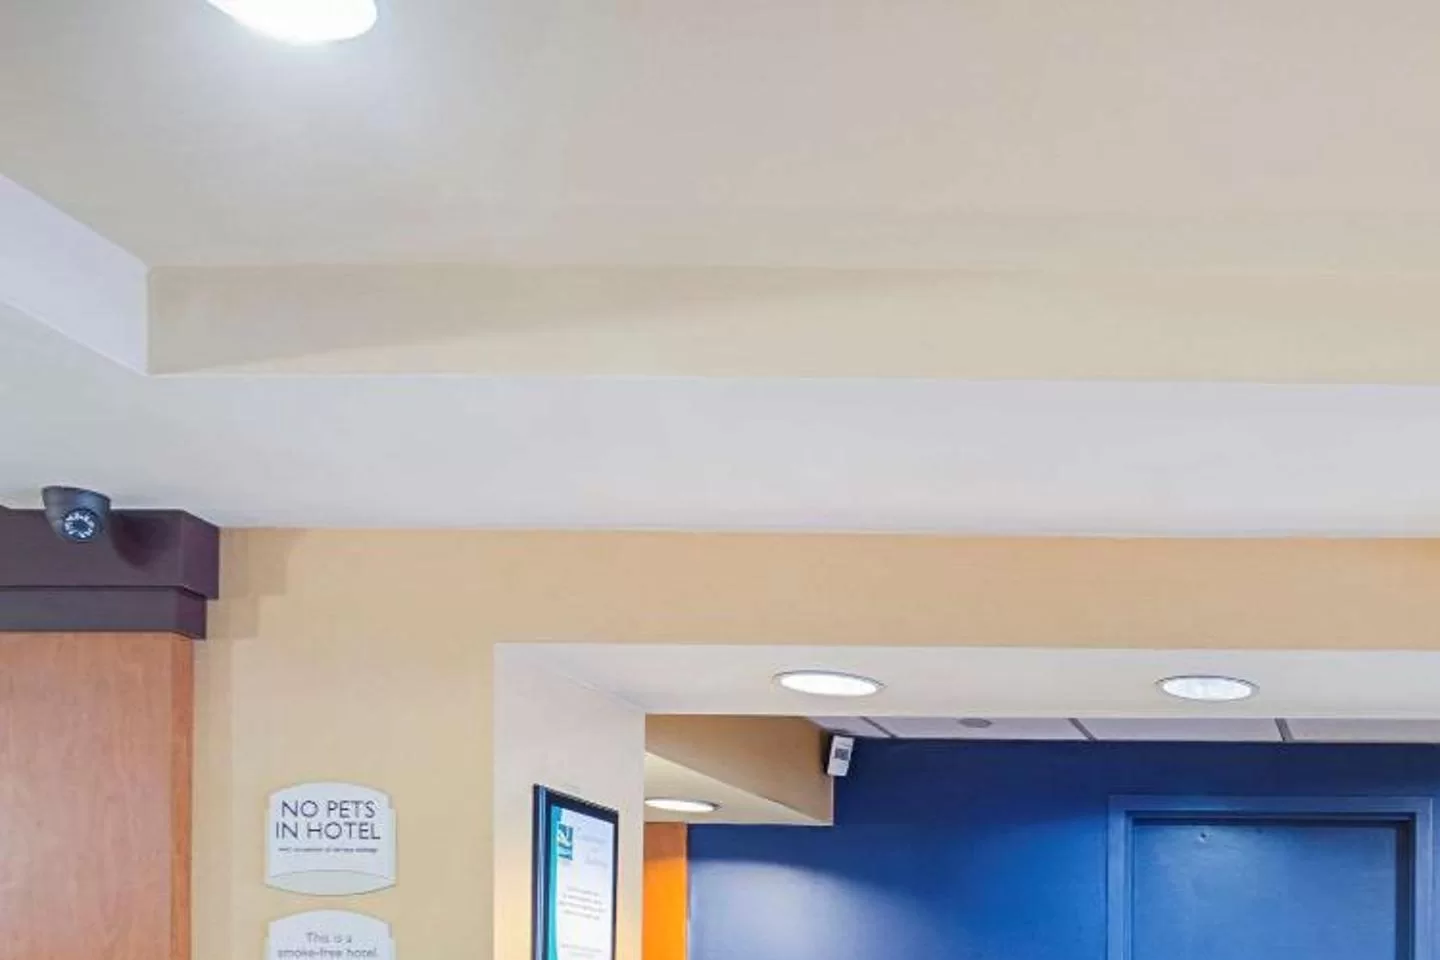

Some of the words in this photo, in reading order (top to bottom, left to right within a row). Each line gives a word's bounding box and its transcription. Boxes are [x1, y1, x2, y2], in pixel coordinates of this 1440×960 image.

[281, 800, 319, 818] NO
[327, 800, 376, 818] PETS
[276, 821, 298, 839] IN
[307, 821, 381, 840] HOTEL
[306, 932, 329, 943] This
[277, 948, 343, 957] smoke-free
